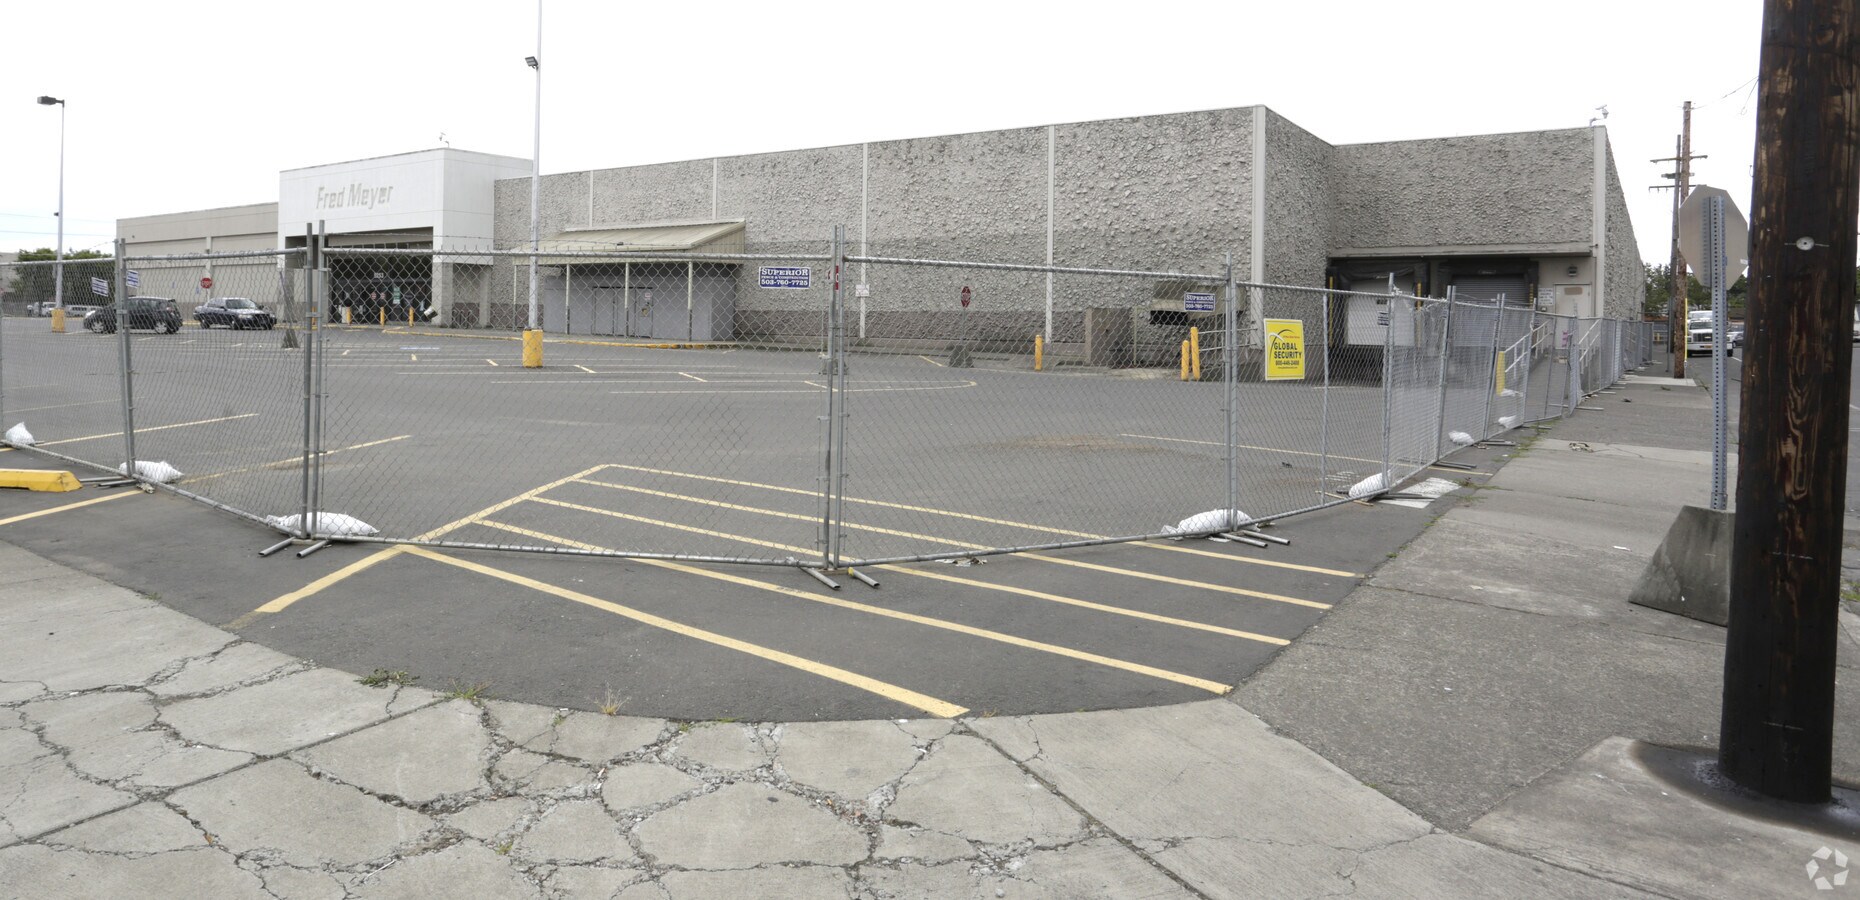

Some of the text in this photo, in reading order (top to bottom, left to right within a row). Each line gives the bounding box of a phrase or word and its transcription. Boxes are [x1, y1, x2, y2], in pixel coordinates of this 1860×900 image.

[316, 183, 394, 210] Fred Meyer
[761, 268, 809, 276] SUPERIOR
[1273, 342, 1298, 350] GLOBAL
[1273, 351, 1303, 359] SECURITY
